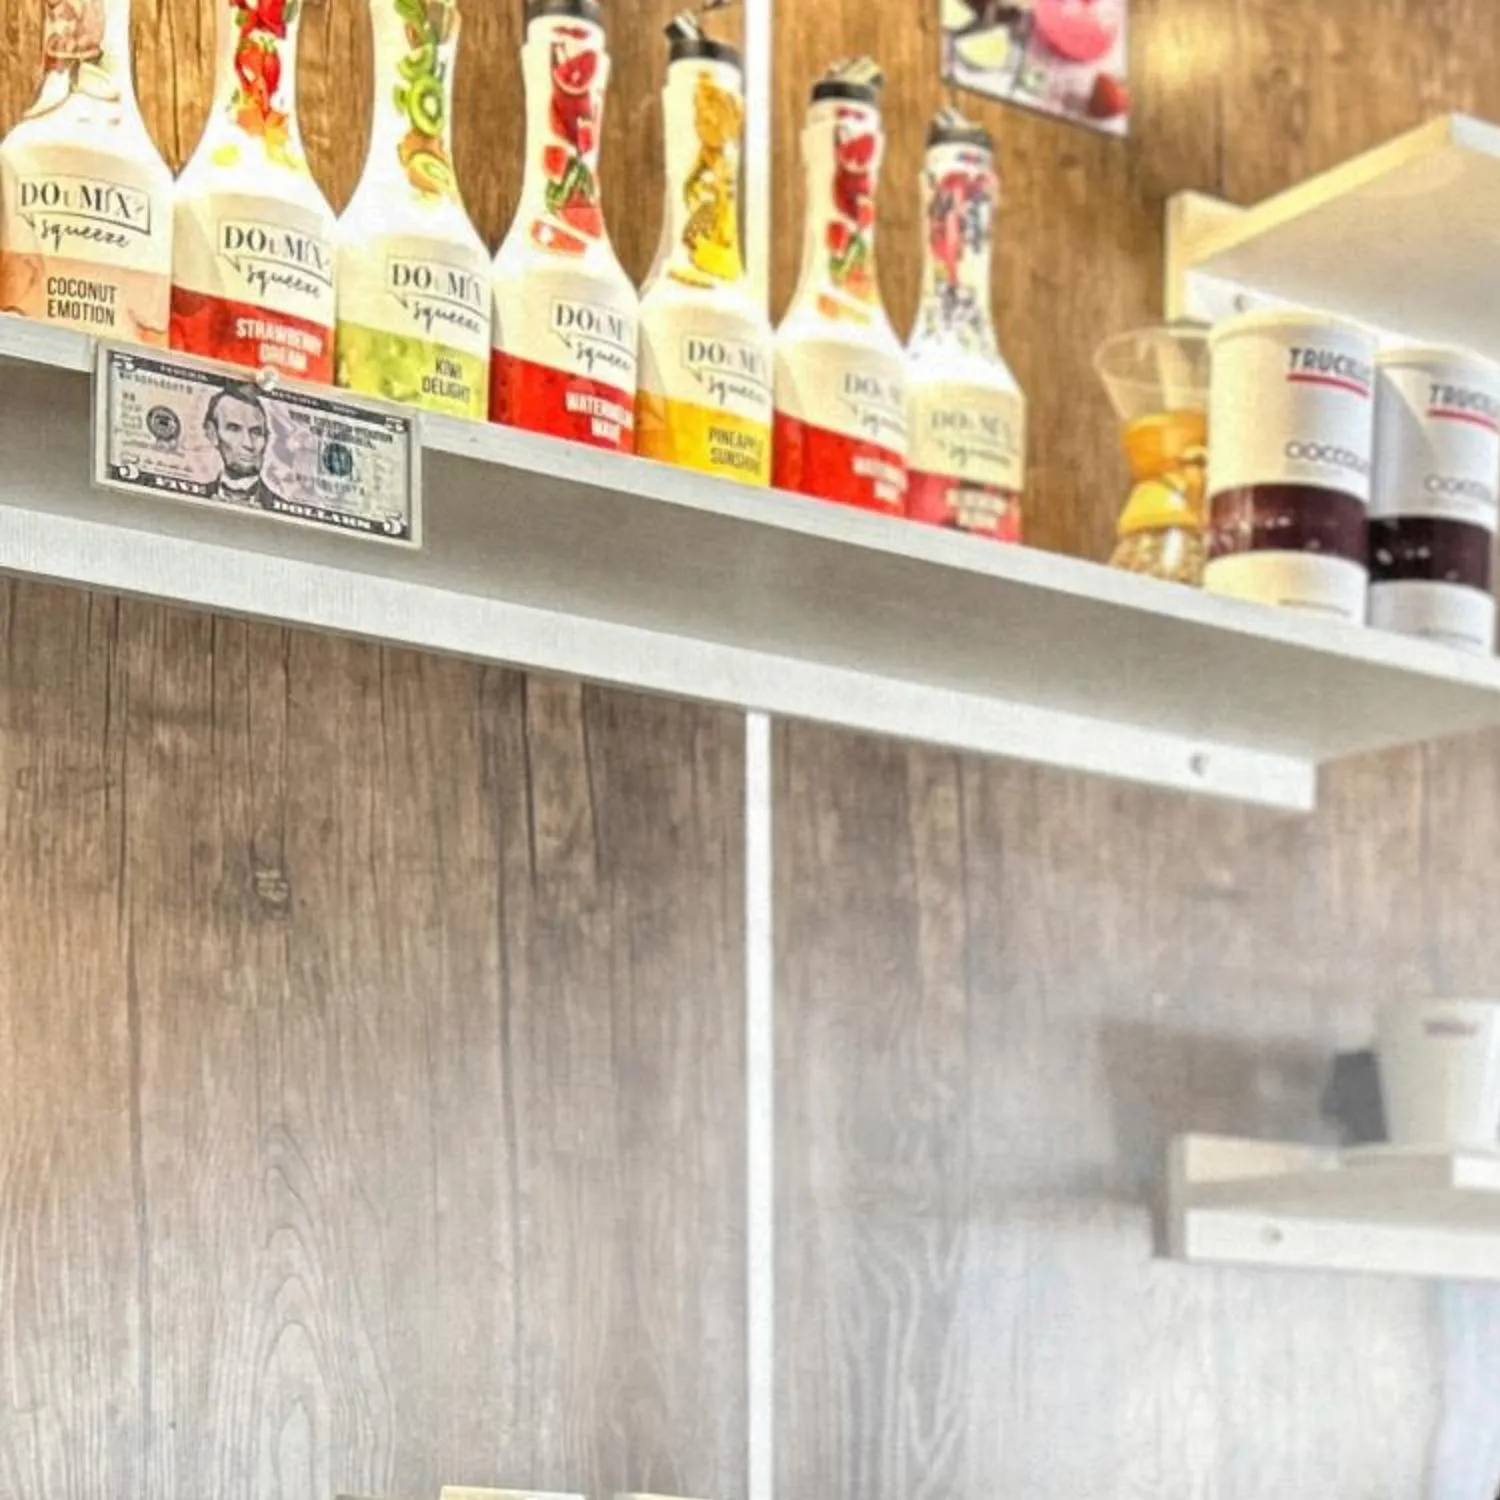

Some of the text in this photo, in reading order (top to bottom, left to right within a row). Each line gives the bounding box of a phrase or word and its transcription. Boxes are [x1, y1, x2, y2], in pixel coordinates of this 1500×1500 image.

[41, 218, 131, 252] squeeze
[46, 276, 119, 304] COCONUT
[46, 298, 116, 328] EMOTION
